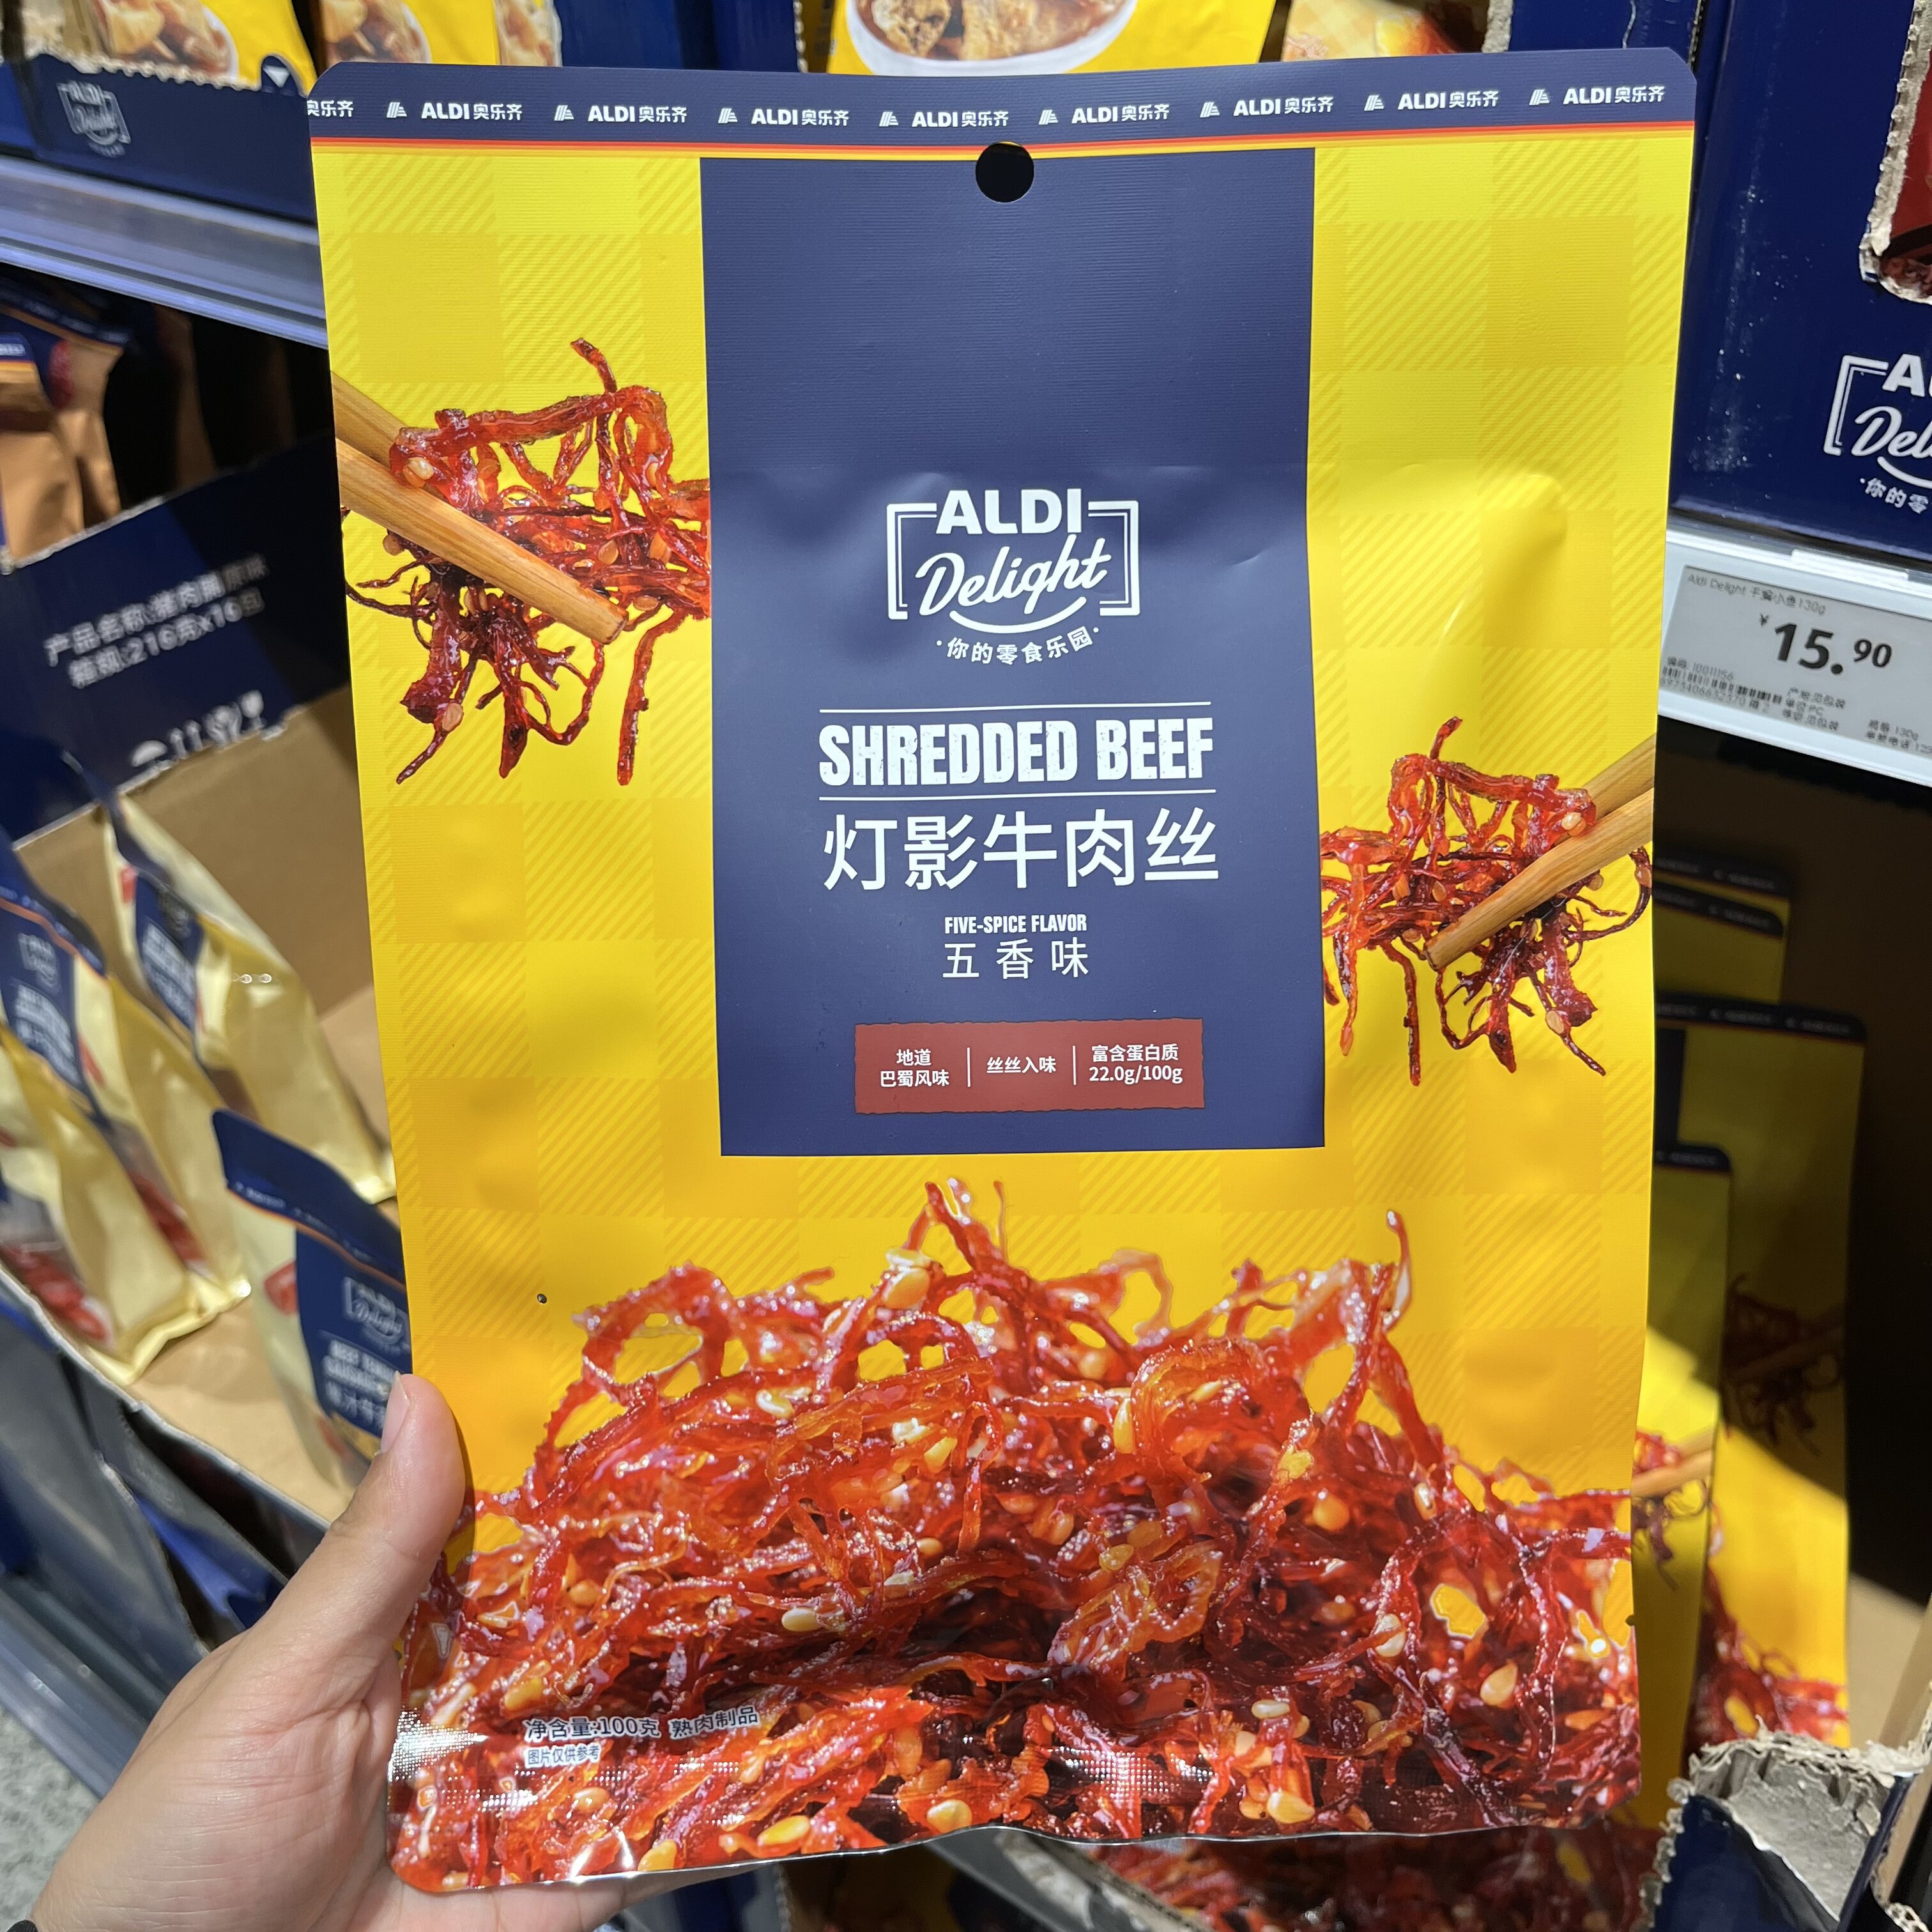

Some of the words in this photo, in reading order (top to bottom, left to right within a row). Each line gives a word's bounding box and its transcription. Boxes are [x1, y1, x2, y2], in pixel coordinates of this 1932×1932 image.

[421, 103, 470, 119] ALDI
[588, 105, 635, 122] ALDI
[751, 109, 798, 125] ALDI
[912, 111, 958, 127] ALDI
[1071, 107, 1117, 123] ALDI
[1233, 99, 1280, 116] ALDI
[1398, 93, 1445, 110] ALDI
[1563, 88, 1611, 105] ALDI
[935, 488, 1082, 535] ALDI
[915, 534, 1112, 616] Delight
[946, 626, 1093, 665] 你的零食乐园
[818, 719, 1078, 786] SHREDDED
[1096, 717, 1213, 780] BEEF
[824, 807, 1219, 891] 灯影牛肉丝
[944, 916, 1027, 934] FIVE-SPICE
[1031, 914, 1087, 933] FLAVOR
[942, 937, 1089, 979] 五香味
[896, 1048, 931, 1066] 地道
[986, 1055, 1057, 1074] 丝丝入味
[1091, 1043, 1179, 1062] 富含蛋白质
[880, 1070, 949, 1087] 巴蜀风味
[1089, 1064, 1183, 1084] 22.0g/100g
[525, 1717, 661, 1740] 净含量:100克
[670, 1706, 759, 1738] 熟肉制品
[527, 1745, 601, 1767] 图片仅供参考
